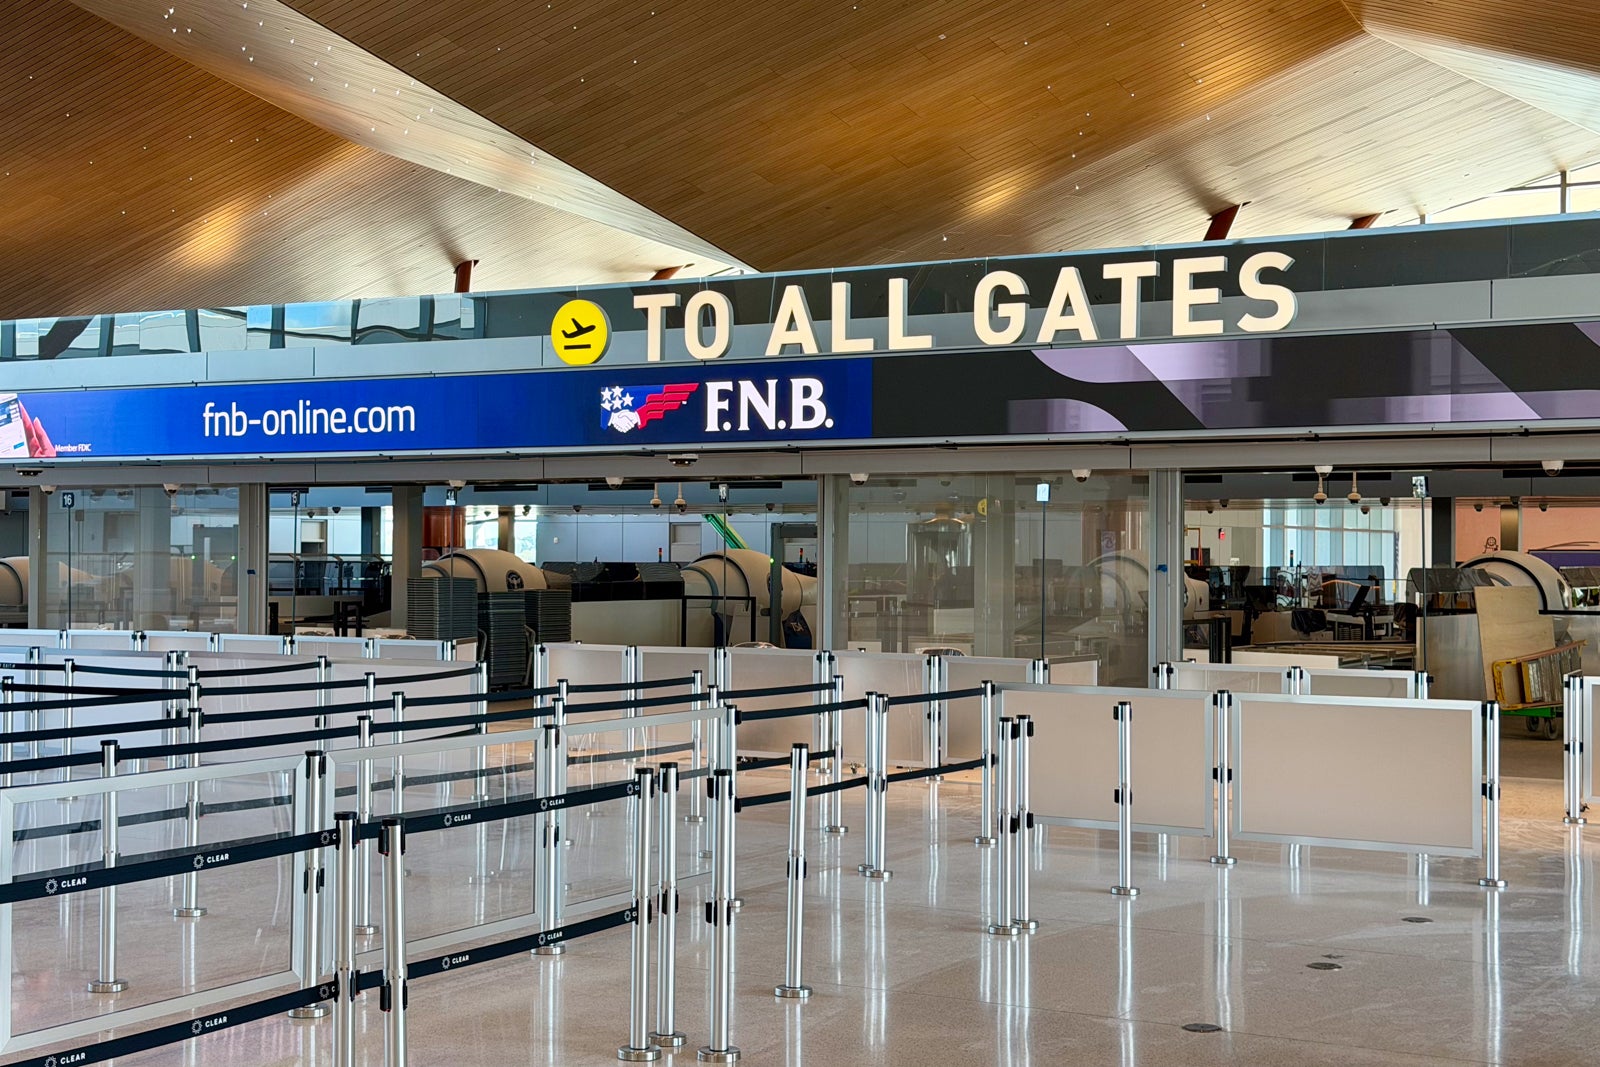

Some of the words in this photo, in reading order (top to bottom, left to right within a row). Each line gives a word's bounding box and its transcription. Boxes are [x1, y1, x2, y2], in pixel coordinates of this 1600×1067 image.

[633, 290, 733, 362] TO
[765, 278, 932, 356] ALL
[974, 251, 1296, 345] GATES
[705, 378, 834, 432] F.N.B.
[203, 399, 416, 437] fnb-online.com
[55, 443, 78, 453] Member
[78, 443, 92, 452] FDIC
[63, 494, 73, 506] 16
[453, 814, 472, 822] CLEAR
[206, 853, 230, 863] CLEAR
[61, 877, 87, 888] CLEAR
[547, 932, 563, 940] CLEAR
[451, 955, 470, 964] CLEAR
[205, 1016, 228, 1027] CLEAR
[60, 1053, 86, 1064] CLEAR
